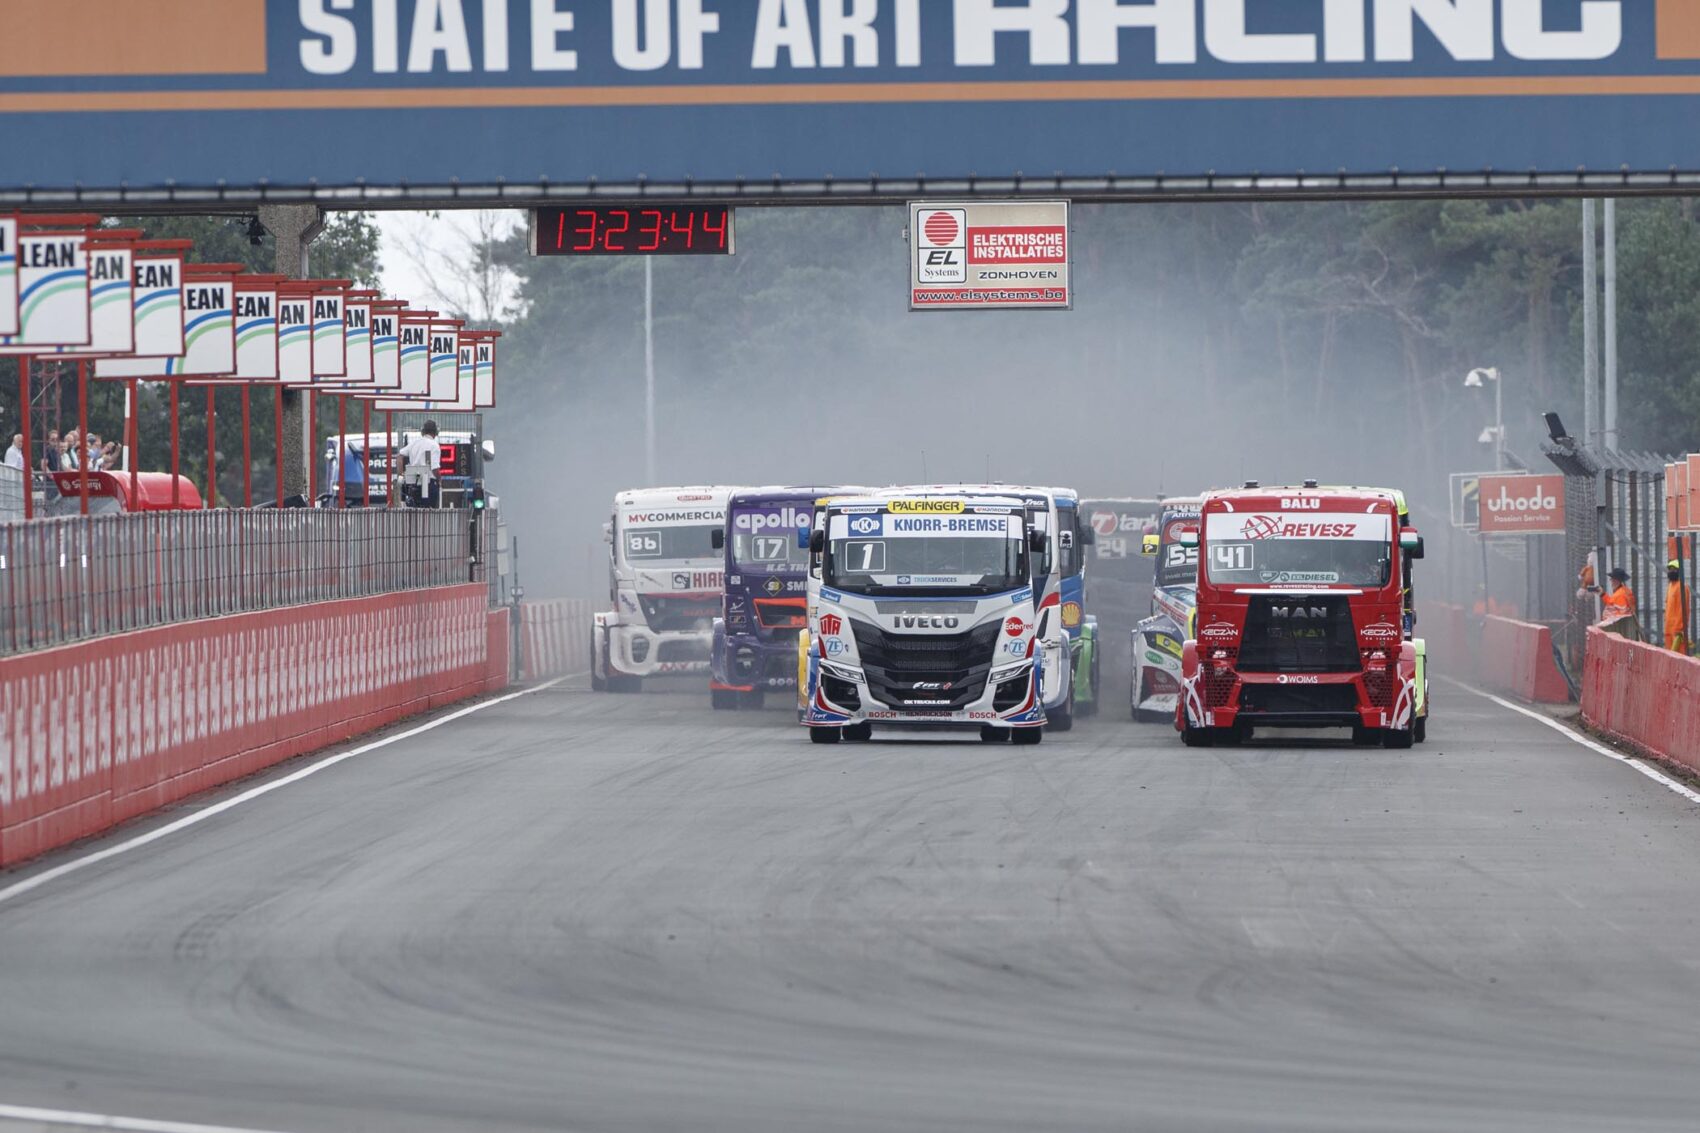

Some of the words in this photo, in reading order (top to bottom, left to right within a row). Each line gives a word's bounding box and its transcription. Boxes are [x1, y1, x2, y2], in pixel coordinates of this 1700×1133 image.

[300, 0, 577, 74] STATE
[611, 0, 719, 71] OF
[751, 0, 921, 69] ART
[954, 0, 1622, 66] RACING
[557, 210, 727, 250] 13:23:44
[973, 233, 1063, 246] ELEKTRISCHE
[926, 250, 958, 265] EL
[973, 246, 1064, 258] INSTALLATIES
[925, 268, 959, 278] Systems
[979, 271, 1058, 279] ZONHOVEN
[916, 289, 1063, 302] www.elsystems.be
[1281, 498, 1320, 509] BALU
[1487, 485, 1557, 511] uhoda
[892, 501, 960, 511] PALFINGER
[629, 511, 727, 523] MVCOMMERCIA
[736, 508, 811, 534] apollo
[1524, 514, 1551, 522] Service
[894, 519, 1006, 531] KNORR-BREMSE
[756, 538, 783, 559] 17
[1096, 539, 1127, 558] 24
[1169, 544, 1199, 565] 55
[862, 543, 874, 570] 1
[1217, 547, 1245, 568] 41
[1271, 606, 1328, 618] MAN
[820, 613, 841, 635] UTA
[894, 614, 959, 629] IVECO
[1005, 622, 1034, 631] Edenred
[1288, 675, 1318, 683] WOIMS
[868, 711, 897, 719] BOSCH
[969, 711, 997, 719] BOSCH
